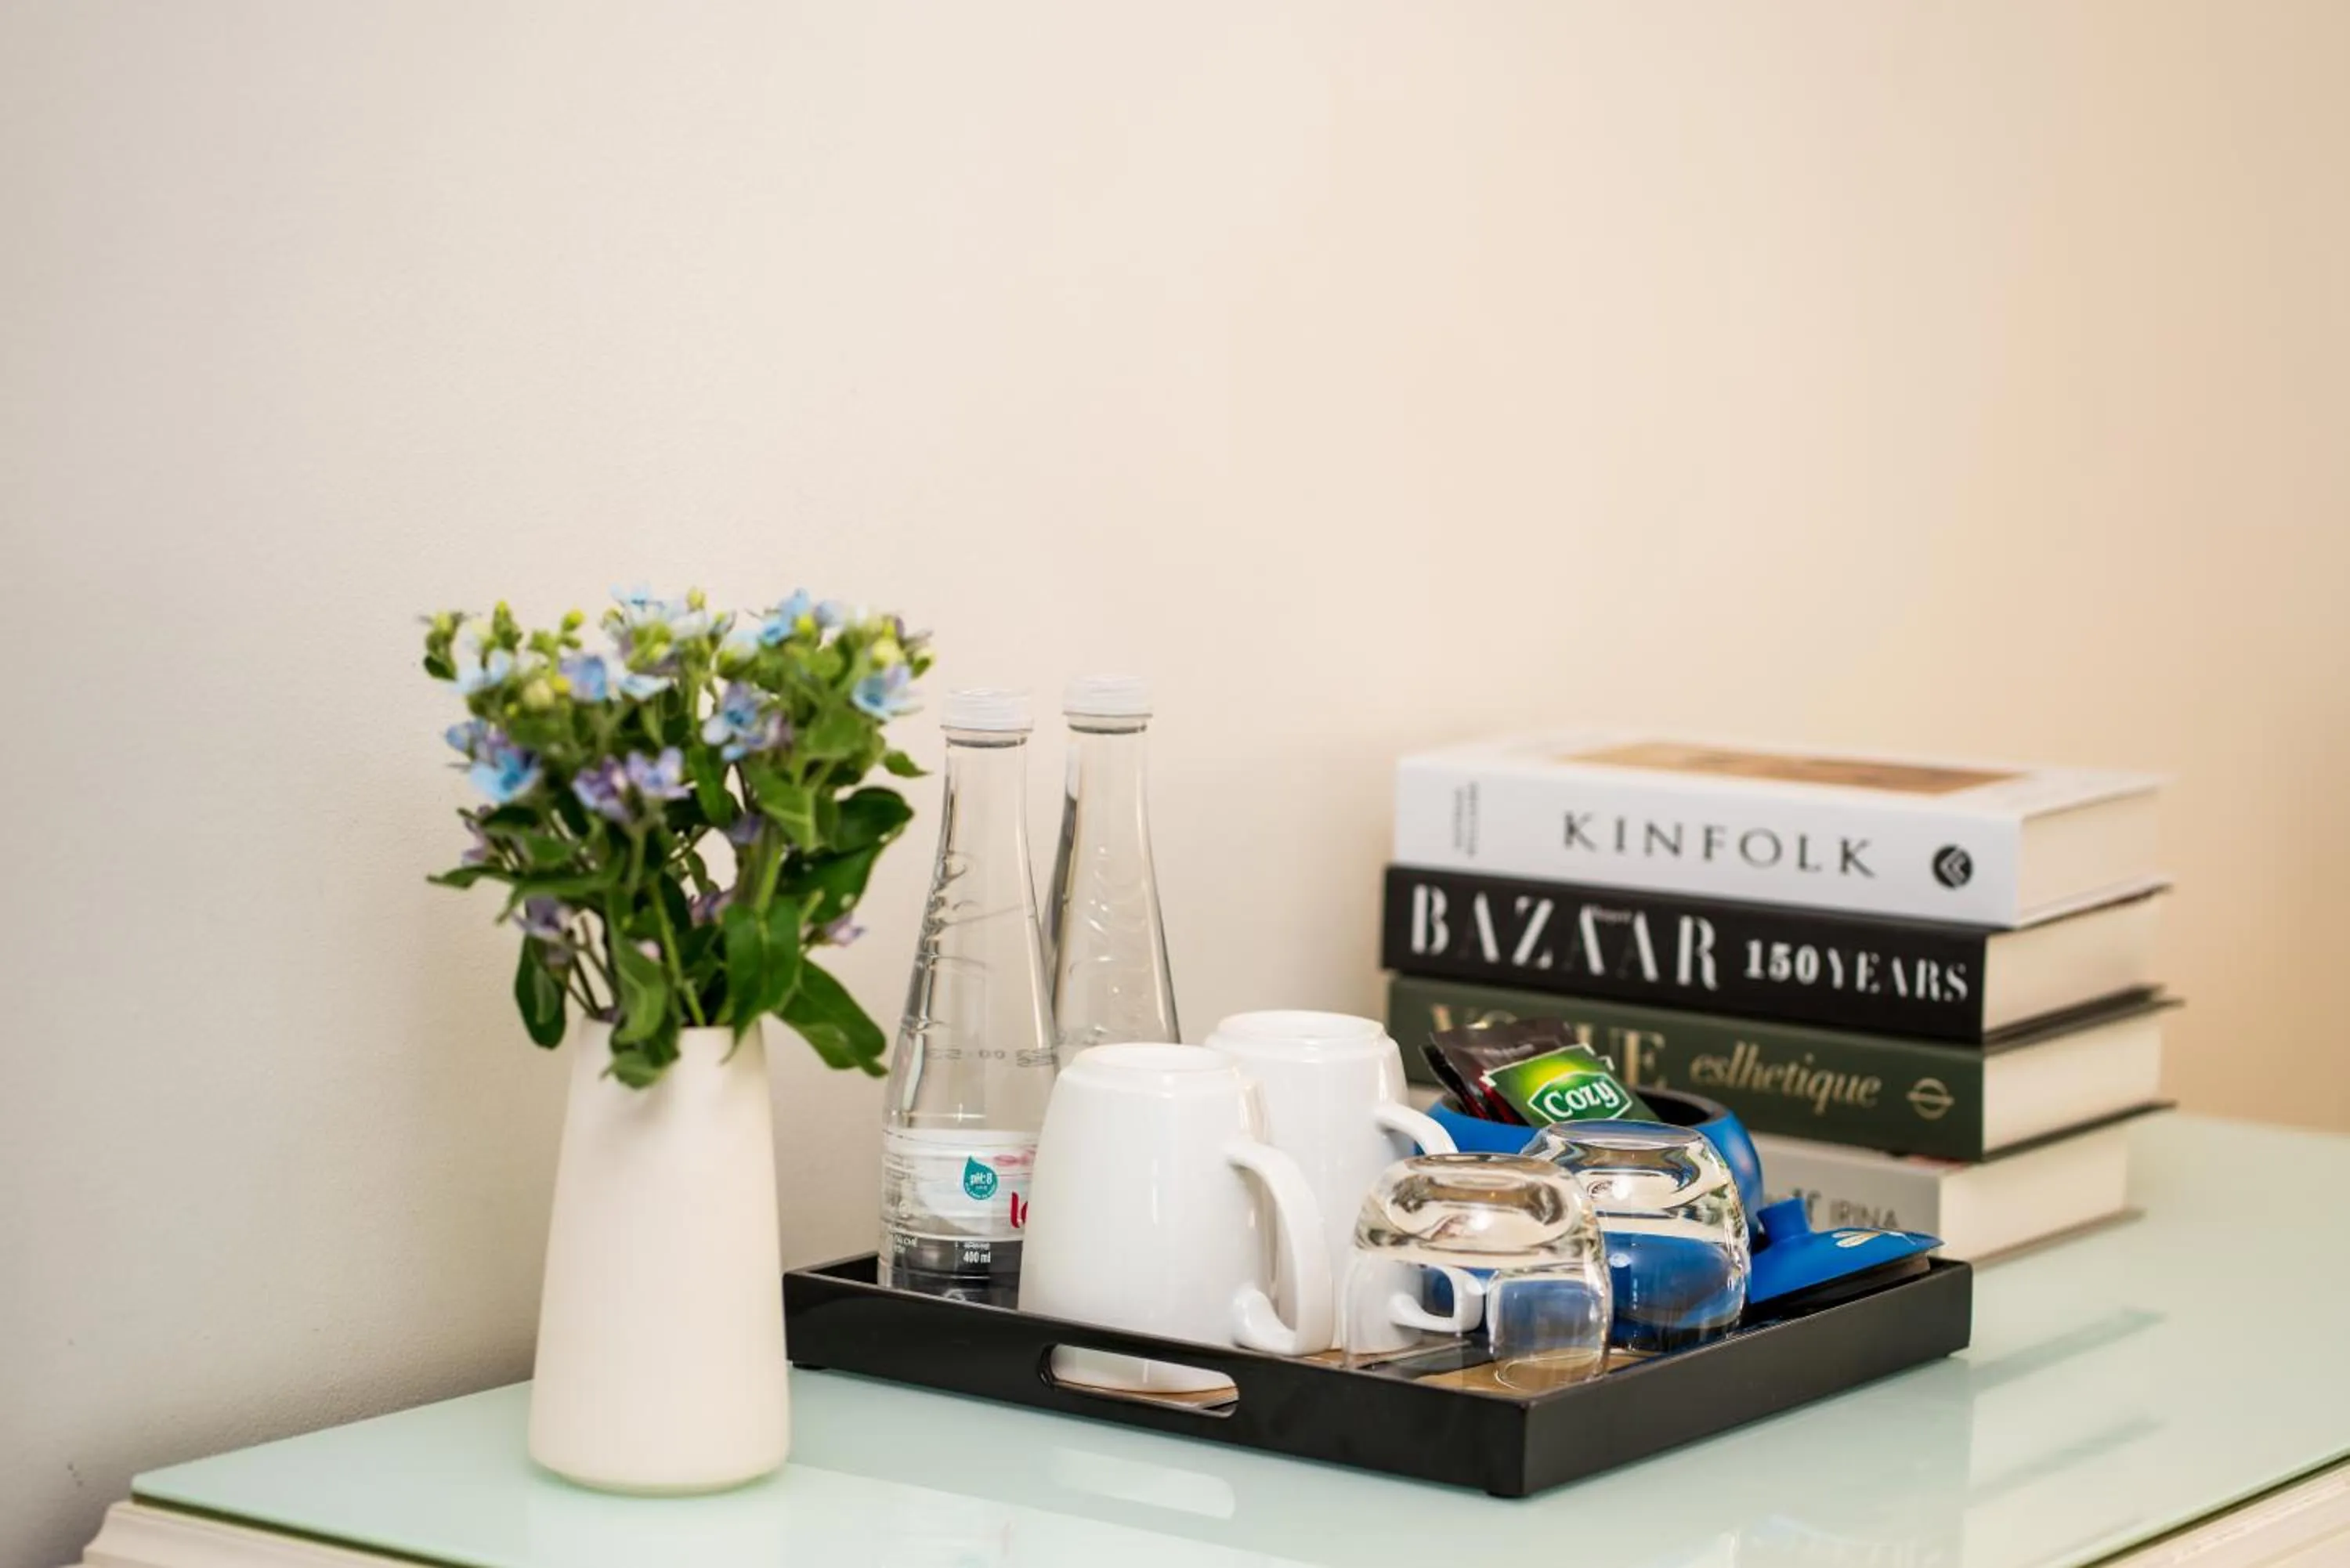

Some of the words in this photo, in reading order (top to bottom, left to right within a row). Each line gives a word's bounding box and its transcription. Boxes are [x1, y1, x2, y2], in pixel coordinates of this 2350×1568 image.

[1564, 811, 1878, 879] KINFOLK
[1412, 882, 1719, 992] BAZAAR
[1744, 939, 1820, 985] 150
[1828, 947, 1969, 1002] YEARS
[1543, 1079, 1619, 1118] Cozy
[963, 1251, 979, 1263] 400
[980, 1251, 991, 1263] ml
